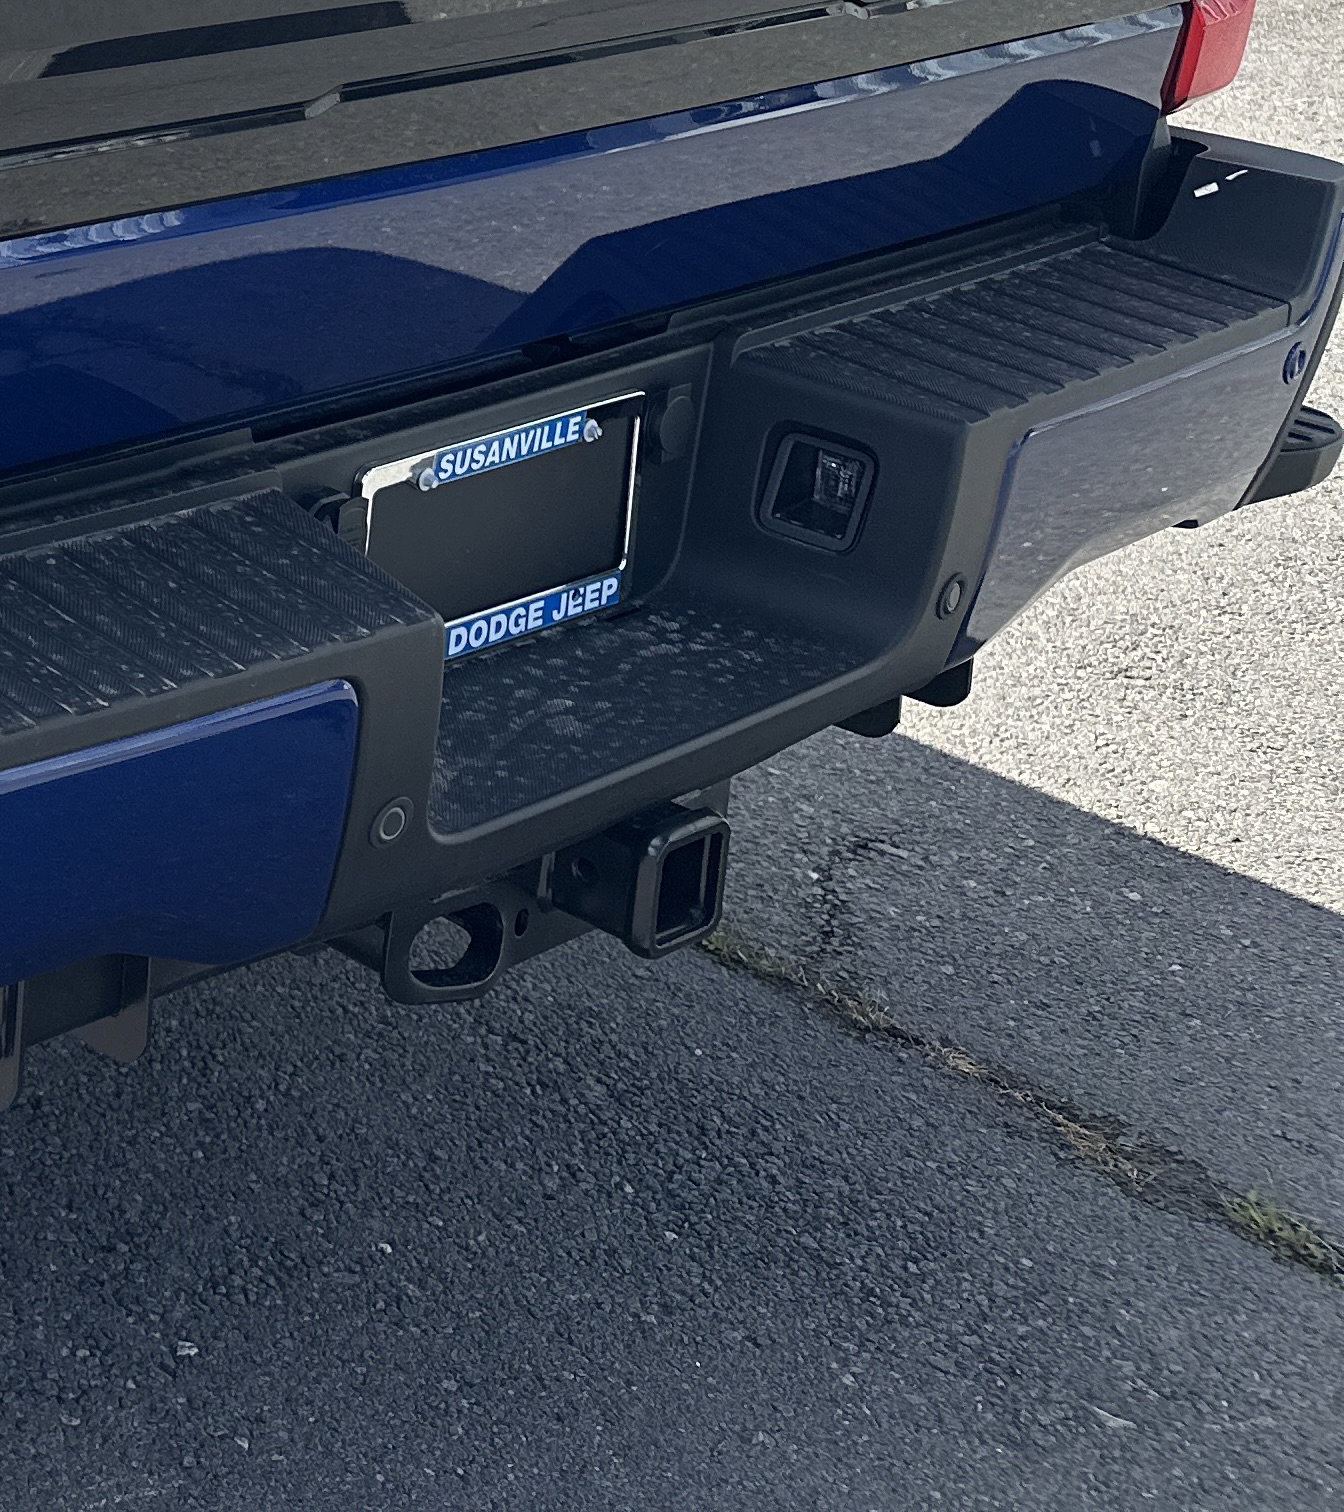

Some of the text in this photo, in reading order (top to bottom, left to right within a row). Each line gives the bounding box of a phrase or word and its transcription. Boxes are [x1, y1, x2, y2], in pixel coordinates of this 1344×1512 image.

[438, 416, 582, 479] SUSANVILLE
[447, 577, 619, 656] DODGE JEEP
